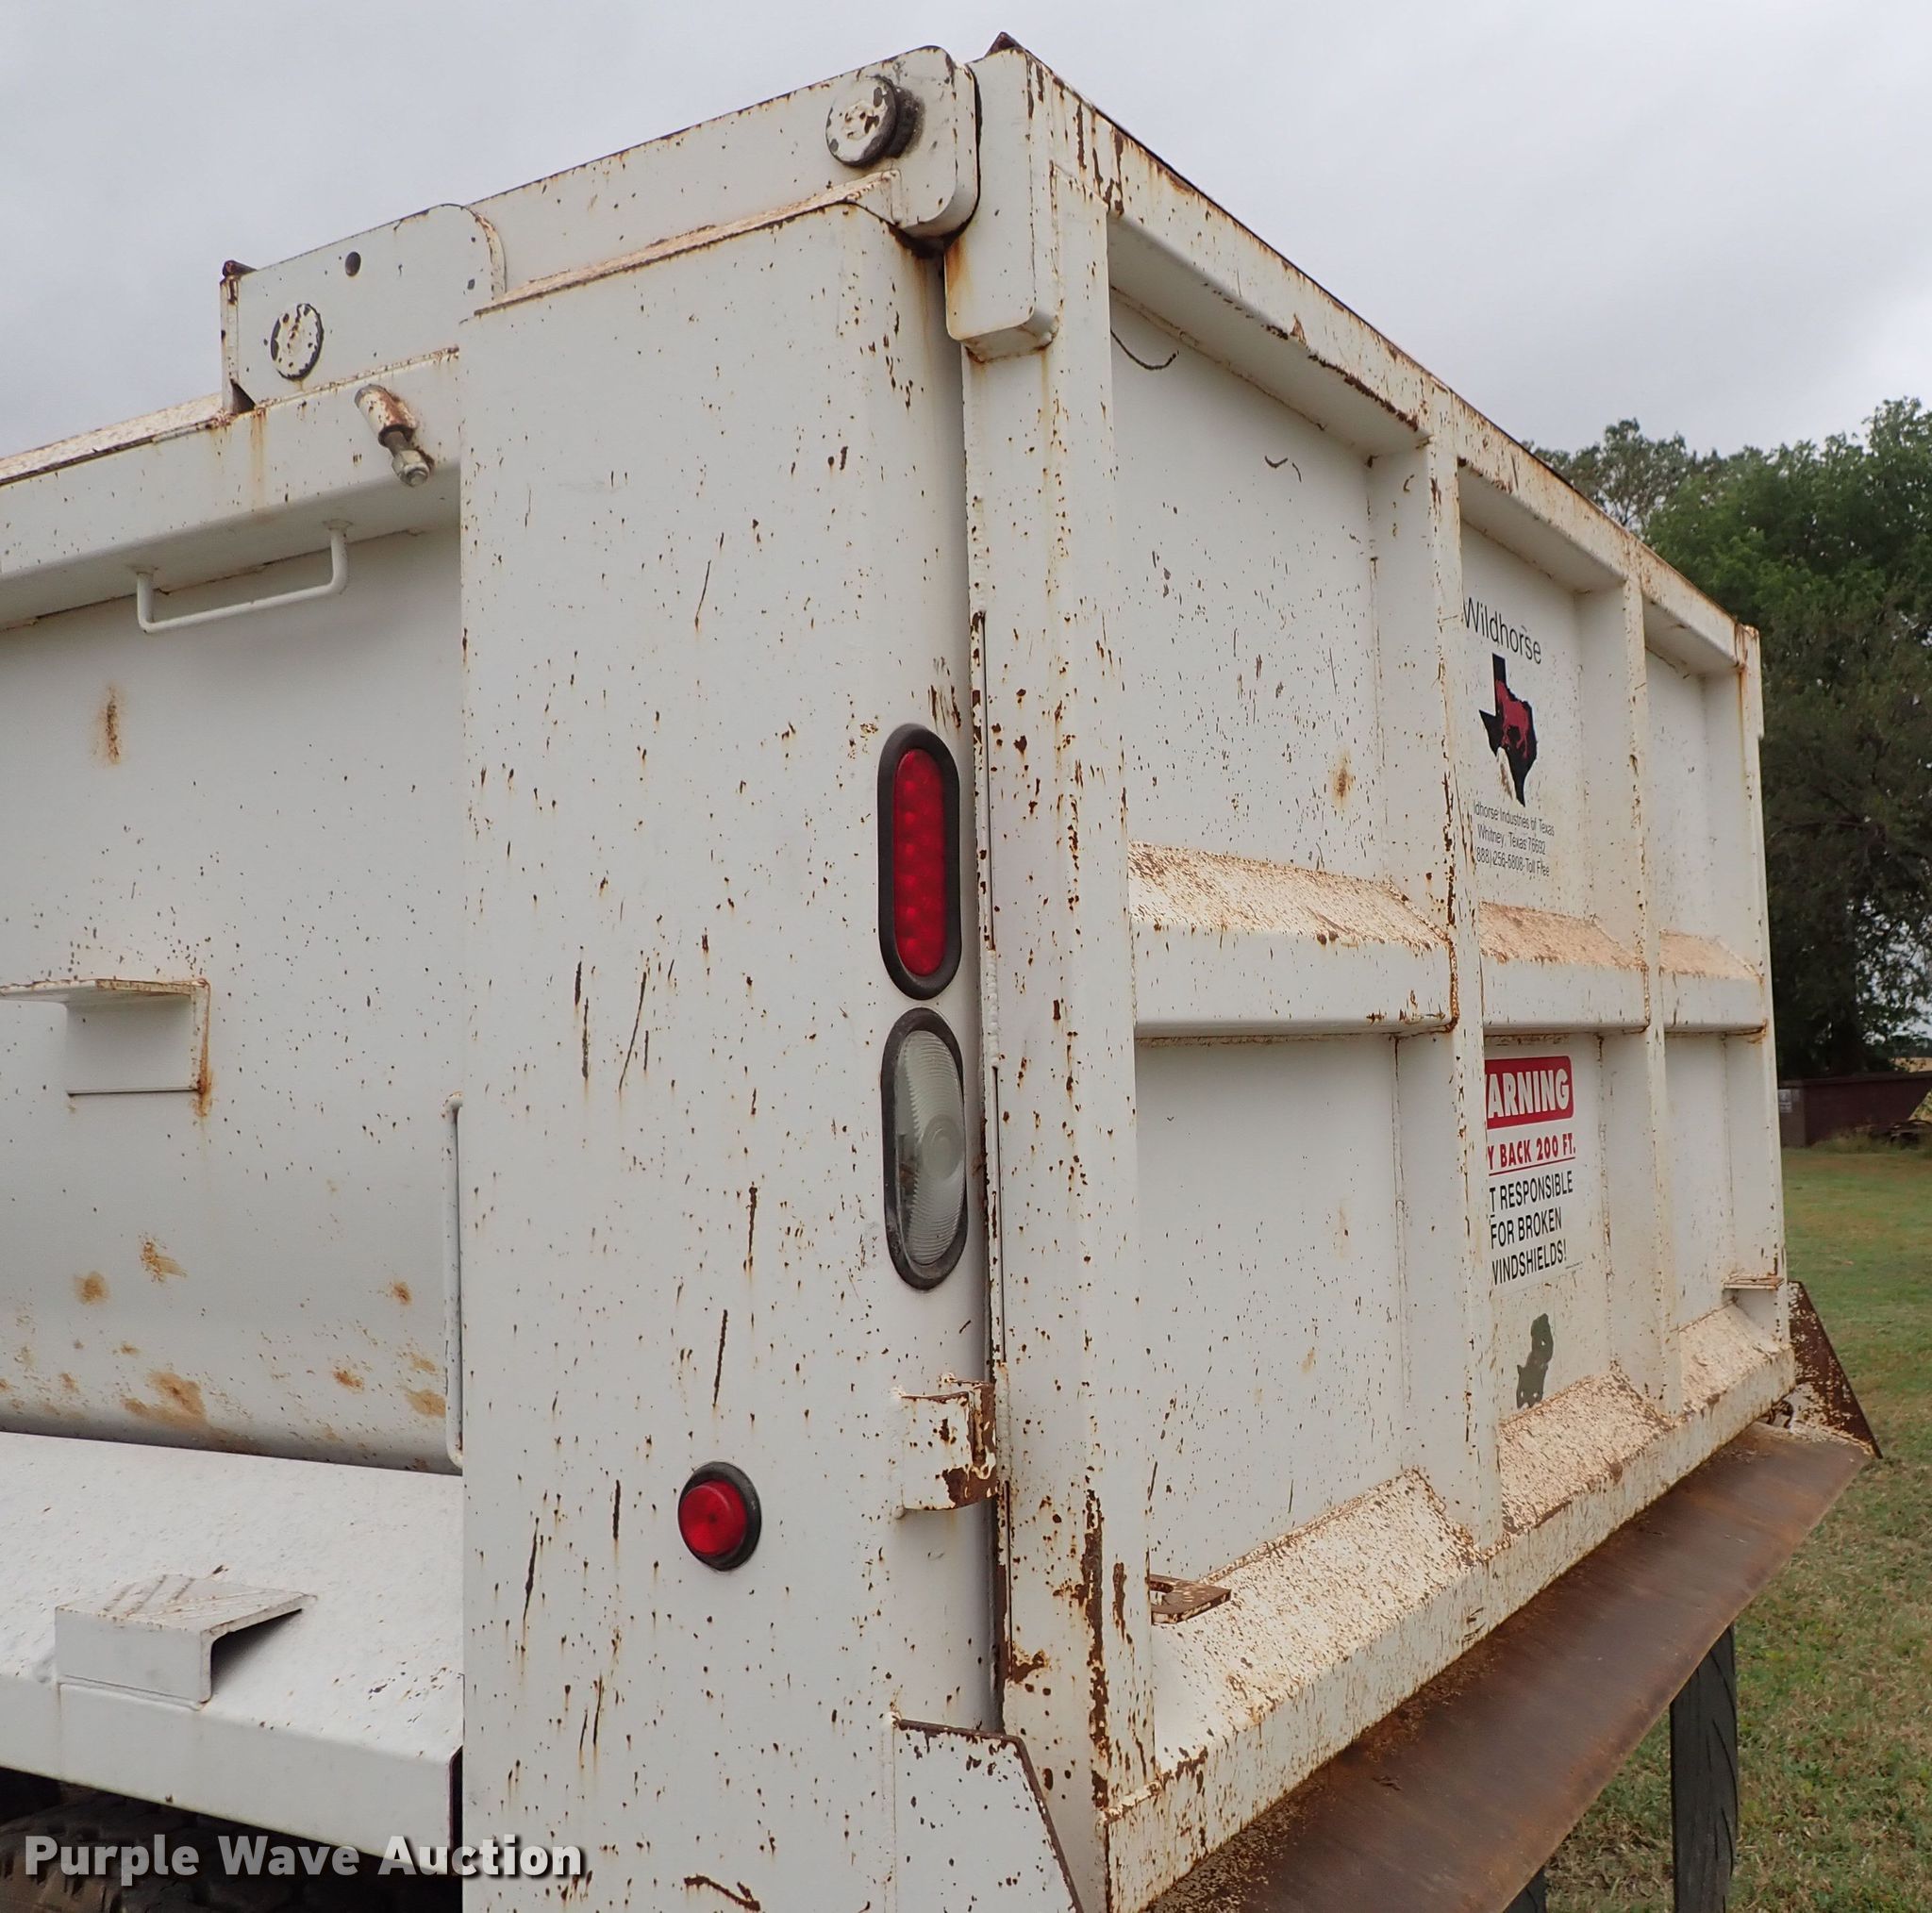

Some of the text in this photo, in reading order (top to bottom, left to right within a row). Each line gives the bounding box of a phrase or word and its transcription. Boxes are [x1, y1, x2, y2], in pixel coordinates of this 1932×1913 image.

[1463, 597, 1541, 664] Wildhorse
[1474, 800, 1498, 821] ldhorse
[1500, 807, 1529, 829] Industries
[1539, 819, 1555, 837] Texas
[1508, 831, 1527, 850] Texas
[1537, 860, 1549, 877] Free
[1486, 1068, 1570, 1119] ARNING
[1500, 1139, 1532, 1168] BACK
[1536, 1135, 1558, 1160] 200
[1562, 1132, 1575, 1156] FT.
[1500, 1171, 1573, 1210] RESPONSIBLE
[1491, 1206, 1562, 1250] FOR BROKEN
